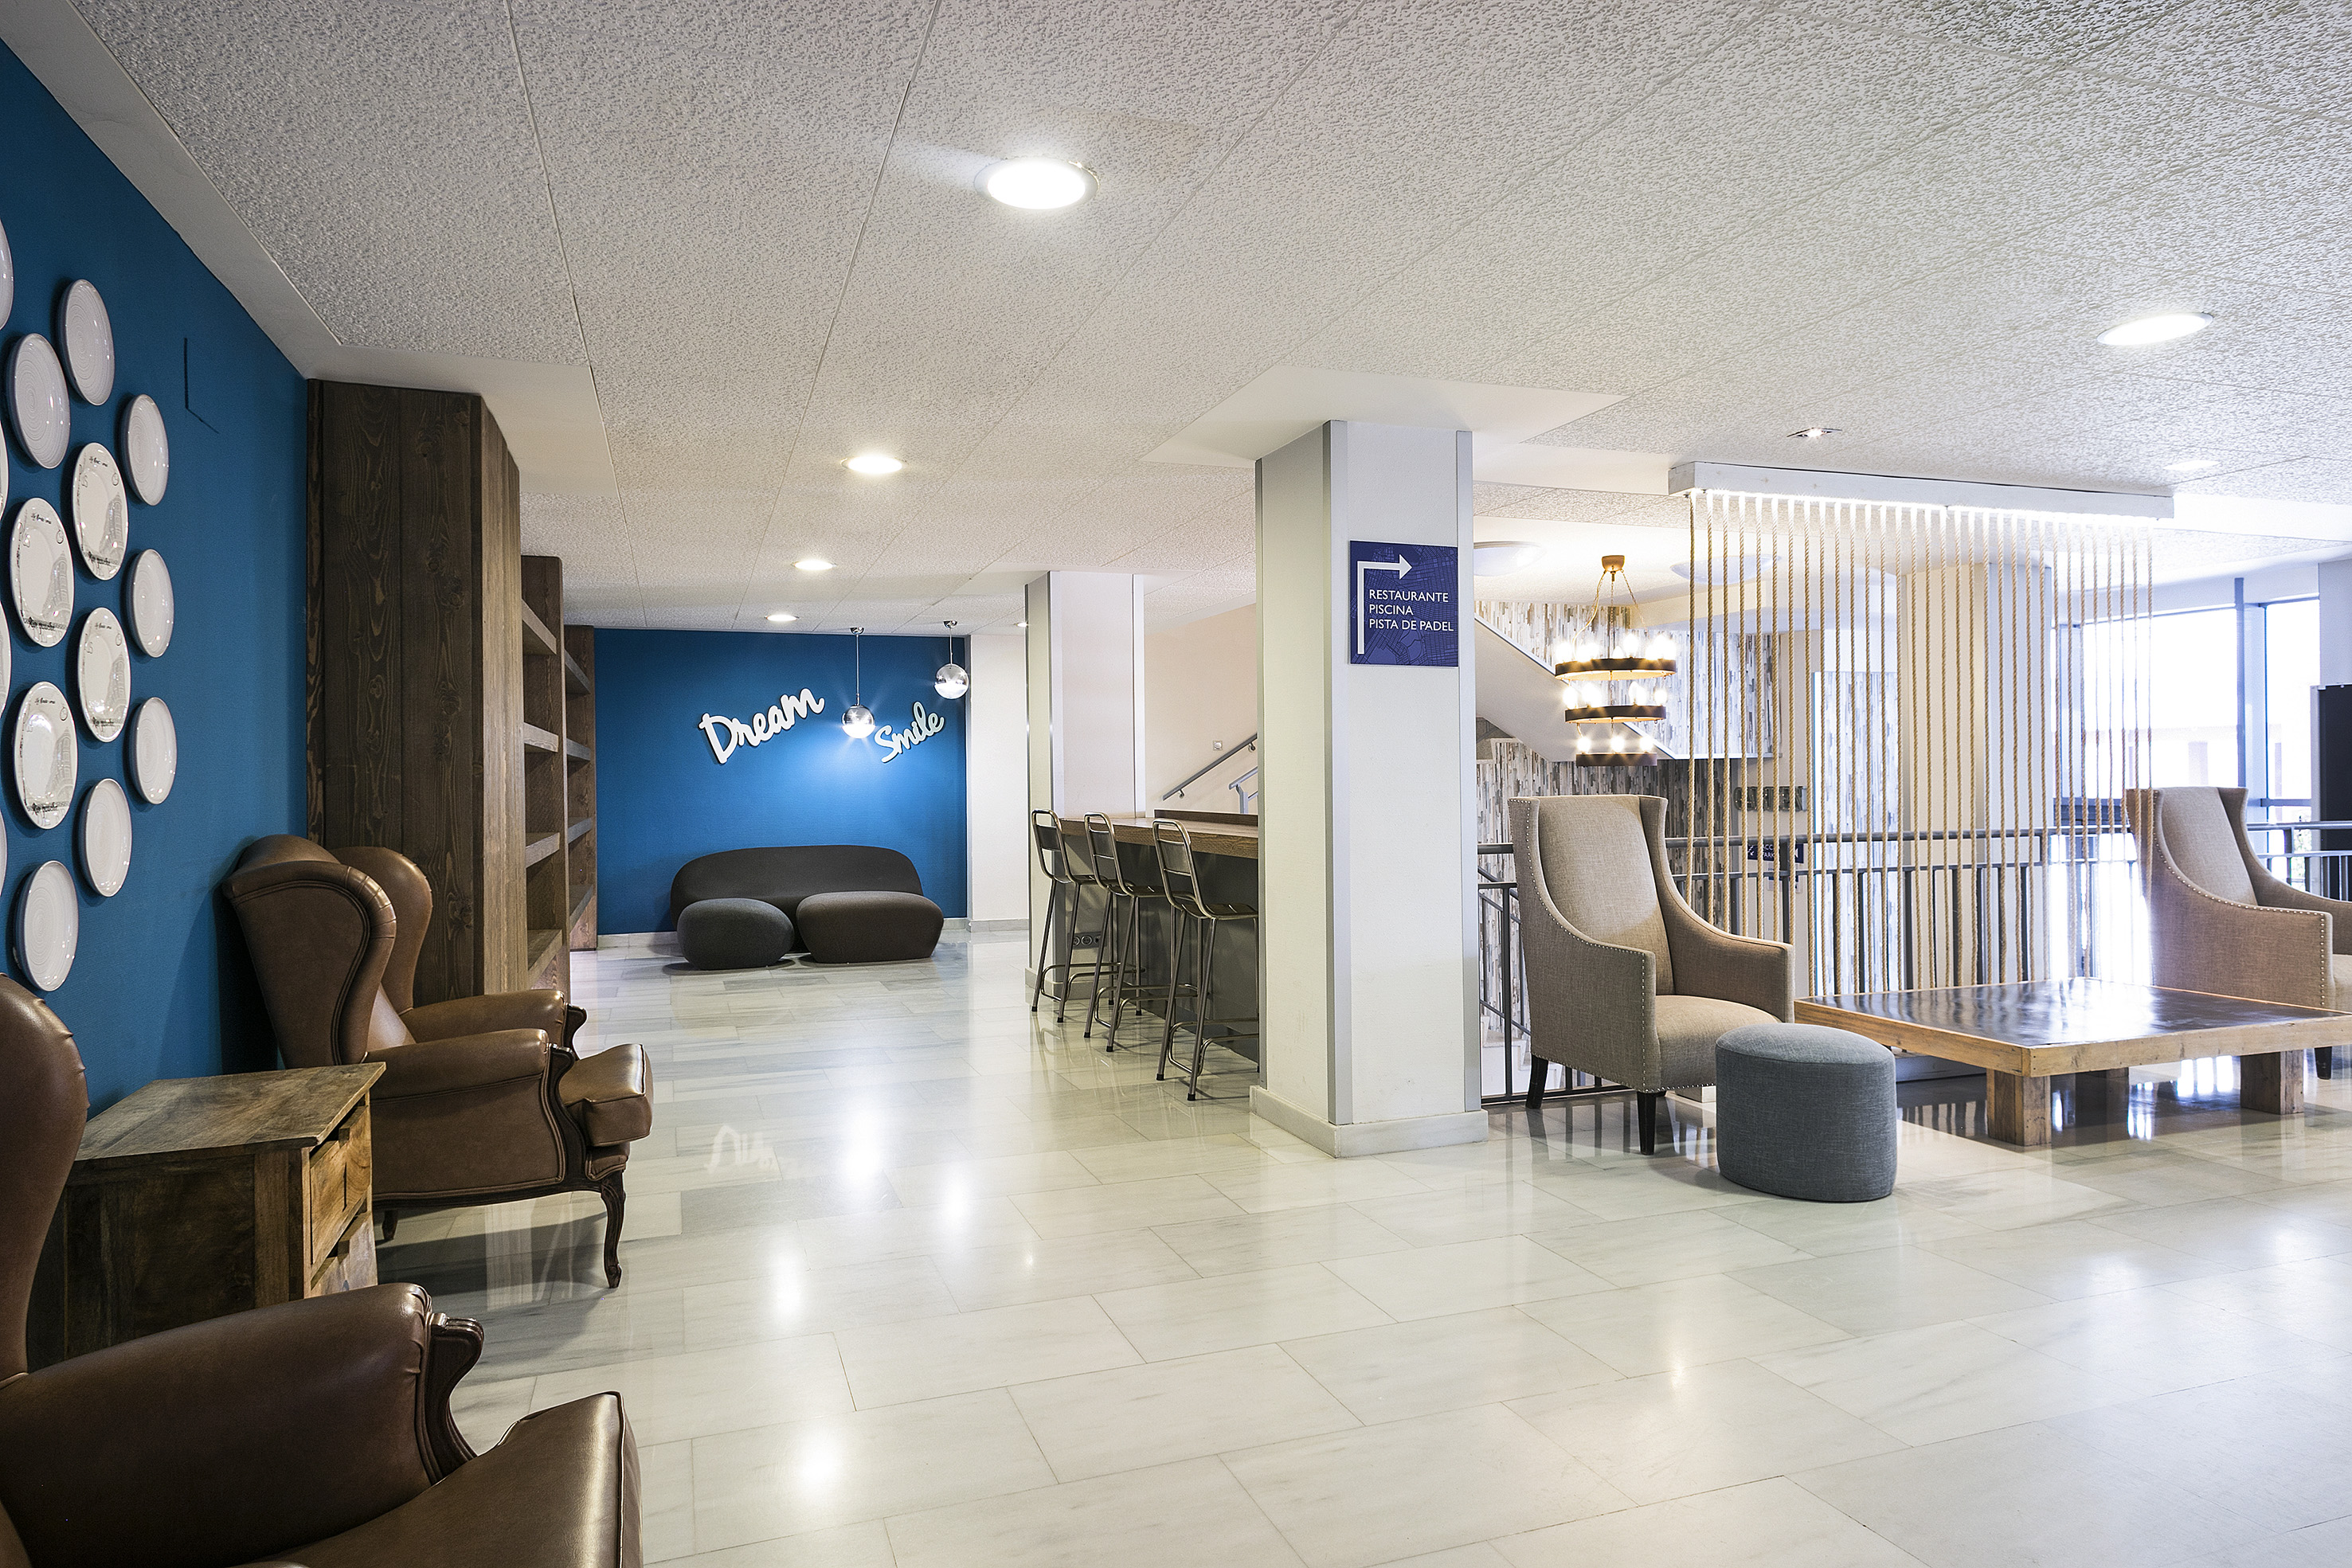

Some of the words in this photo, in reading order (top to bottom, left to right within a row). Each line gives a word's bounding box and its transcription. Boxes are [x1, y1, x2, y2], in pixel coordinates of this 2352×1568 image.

[1369, 589, 1449, 603] RESTAURANTE
[1369, 604, 1414, 616] PISCINA
[1369, 619, 1399, 630] PISTA
[1402, 620, 1417, 631] DE
[1420, 620, 1454, 632] PADEL
[699, 688, 825, 764] Dream
[875, 702, 945, 763] Smile
